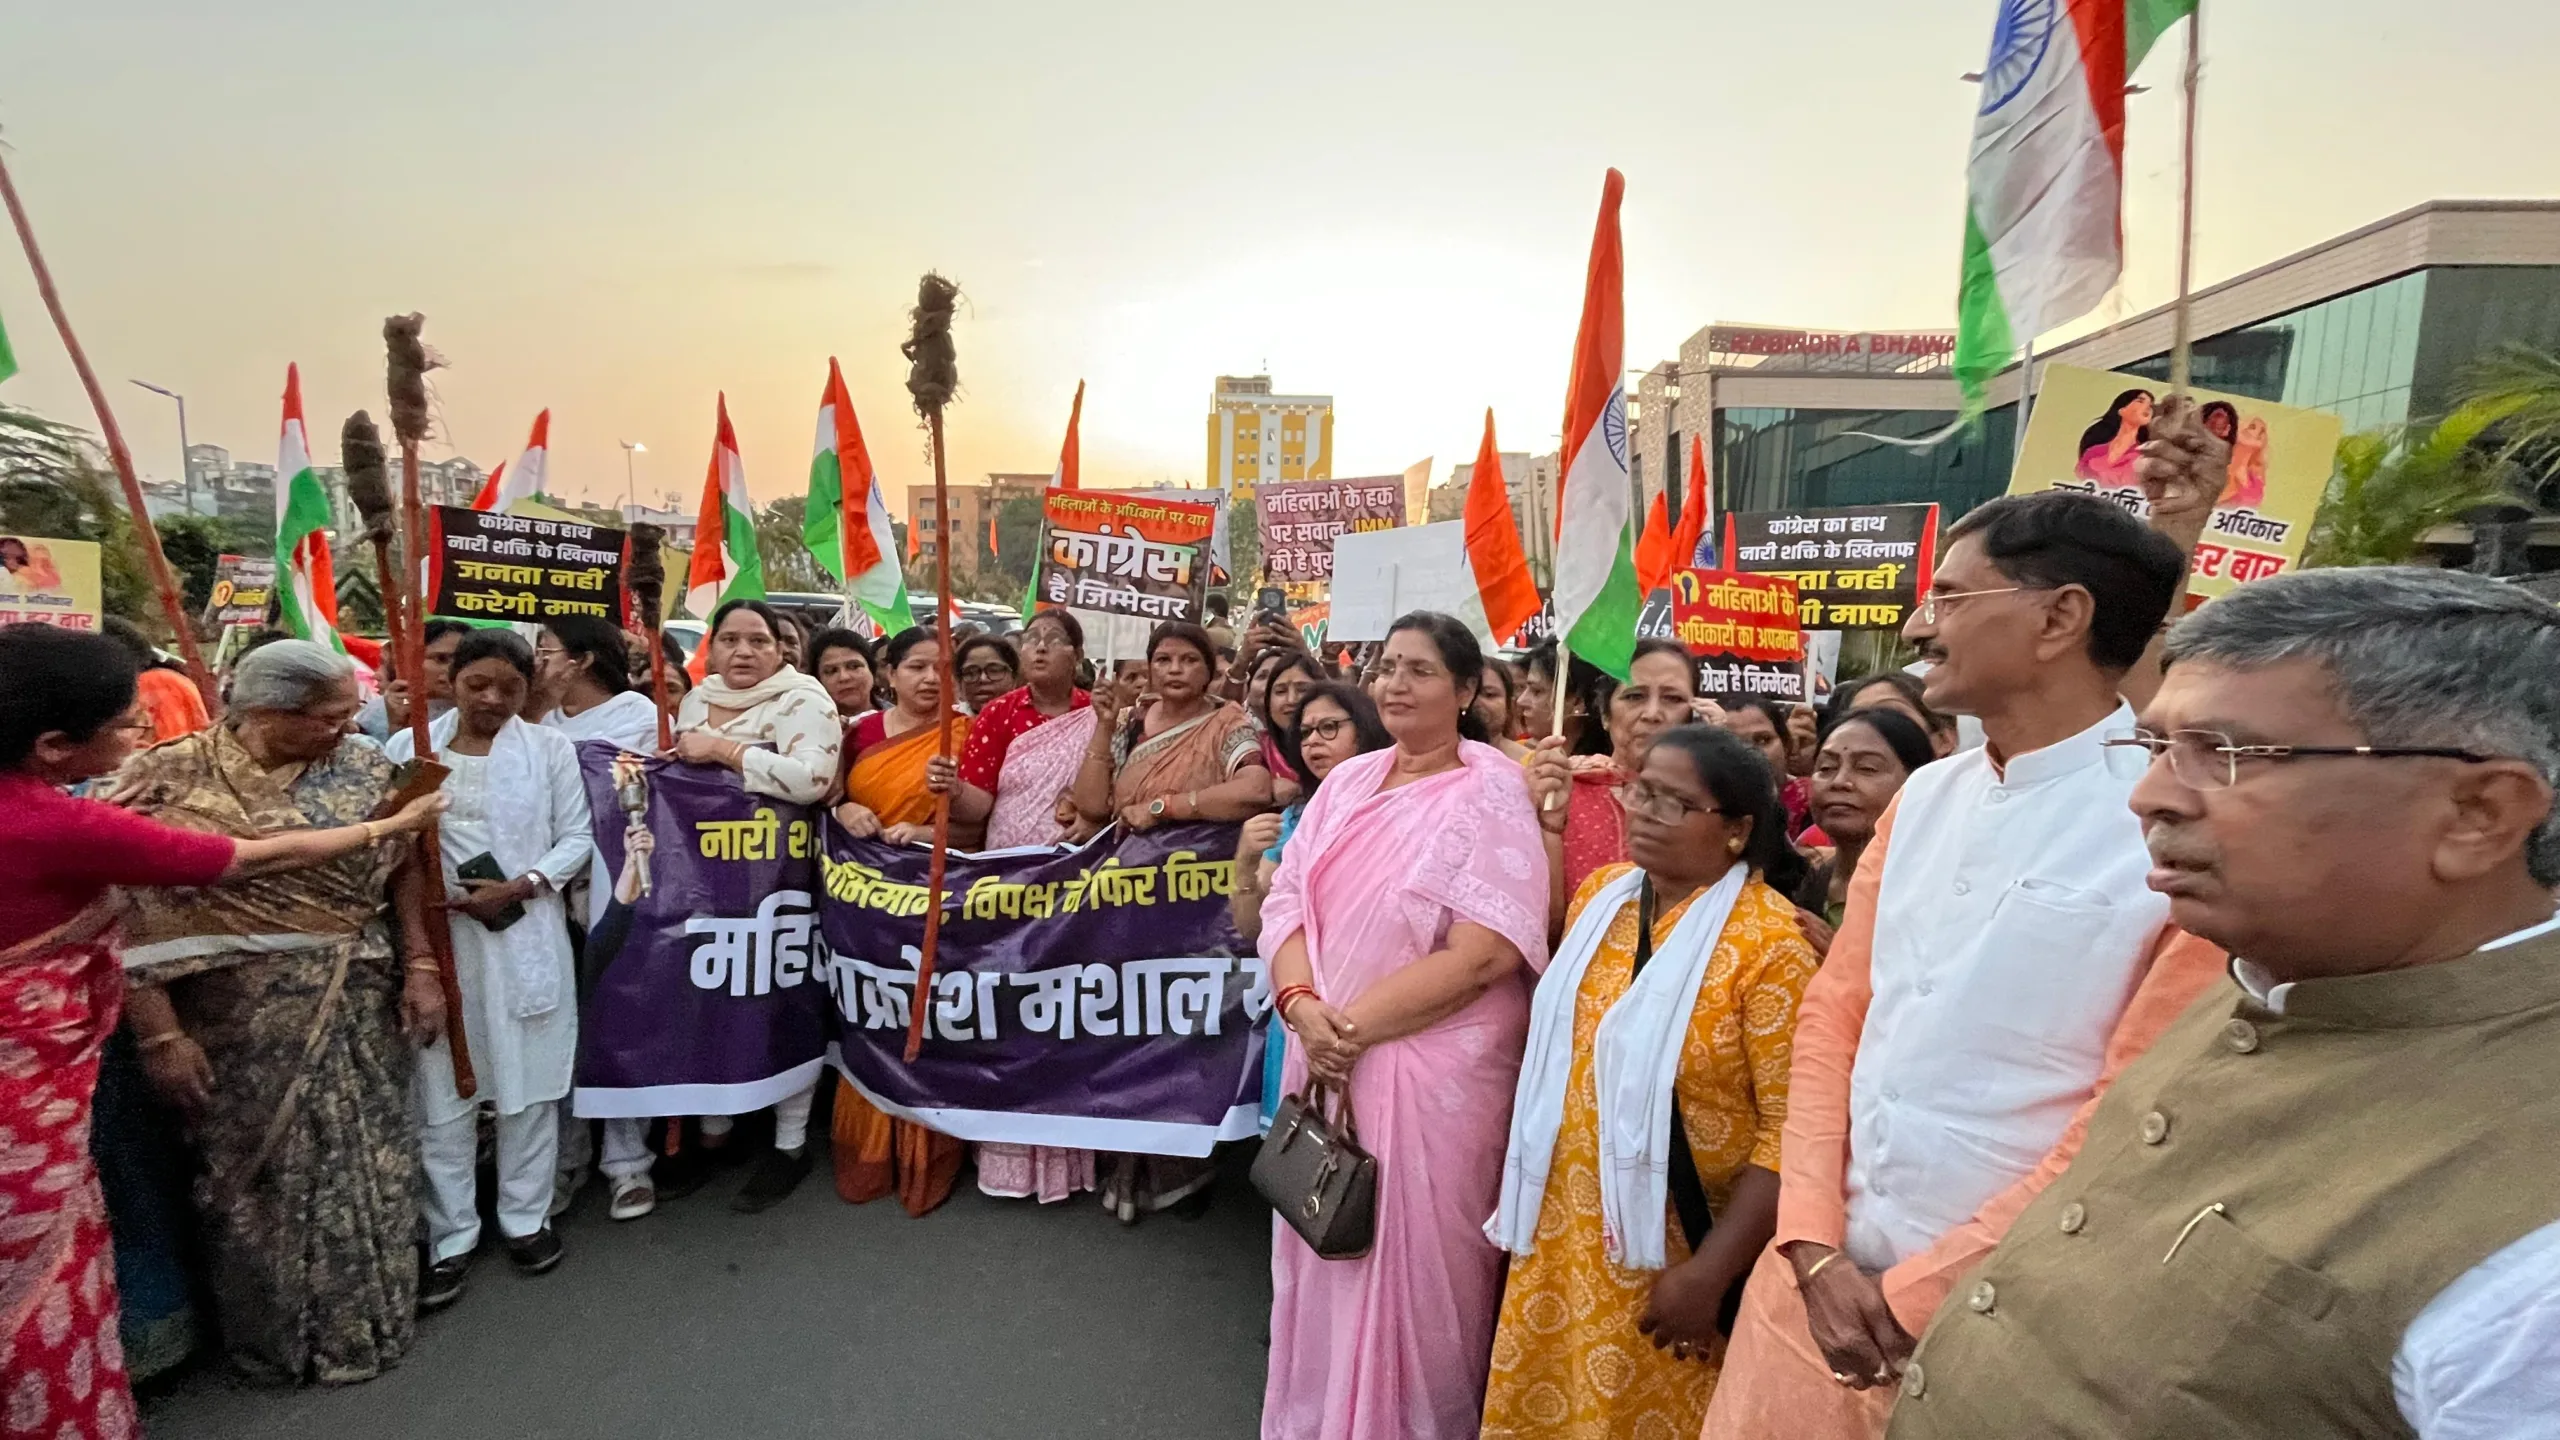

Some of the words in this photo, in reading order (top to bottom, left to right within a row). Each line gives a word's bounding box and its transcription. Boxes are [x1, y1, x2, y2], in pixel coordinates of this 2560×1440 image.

[1870, 335, 1956, 355] BHAWA
[1049, 494, 1098, 513] महिलाओं
[1100, 500, 1112, 514] के
[1115, 502, 1167, 521] अधिकारों
[1169, 511, 1186, 524] पर
[1187, 514, 1209, 527] वार
[1265, 485, 1341, 513] महिलाओं
[1343, 484, 1361, 508] के
[1364, 487, 1395, 507] हक
[535, 519, 557, 536] का
[561, 523, 592, 540] हाथ
[1269, 524, 1293, 543] पर
[1295, 521, 1346, 542] सवाल
[1768, 515, 1821, 535] कांग्रेस
[1823, 517, 1848, 533] का
[1850, 516, 1888, 533] हाथ
[2214, 510, 2289, 542] अधिकार
[447, 535, 489, 553] नारी
[493, 538, 534, 557] शक्ति
[535, 541, 556, 559] के
[557, 543, 619, 565] खिलाफ
[1051, 524, 1198, 585] कांग्रेस
[1269, 548, 1293, 573] की
[1294, 548, 1308, 571] है
[1310, 551, 1334, 577] पुर
[1739, 541, 1779, 561] नारी
[1780, 540, 1821, 560] शक्ति
[1823, 540, 1842, 559] के
[1845, 538, 1917, 560] खिलाफ
[454, 560, 544, 585] जनता
[548, 567, 611, 591] नहीं
[1834, 562, 1906, 591] नहीं
[454, 589, 539, 616] करेगी
[1048, 573, 1070, 604] है
[1075, 578, 1190, 619] जिम्मेदार
[1780, 585, 1796, 617] के
[1828, 604, 1904, 626] माफ
[1677, 614, 1737, 647] अधिकारों
[1738, 625, 1755, 648] का
[1757, 627, 1800, 651] अपमान
[1729, 662, 1742, 692] है
[1743, 664, 1802, 696] जिम्मेदार
[696, 807, 780, 861] नारी
[963, 875, 1058, 921] विपक्ष
[1090, 857, 1158, 911] फिर
[1163, 851, 1237, 903] किय
[685, 890, 829, 996] महि
[1010, 957, 1232, 1041] मशाल
